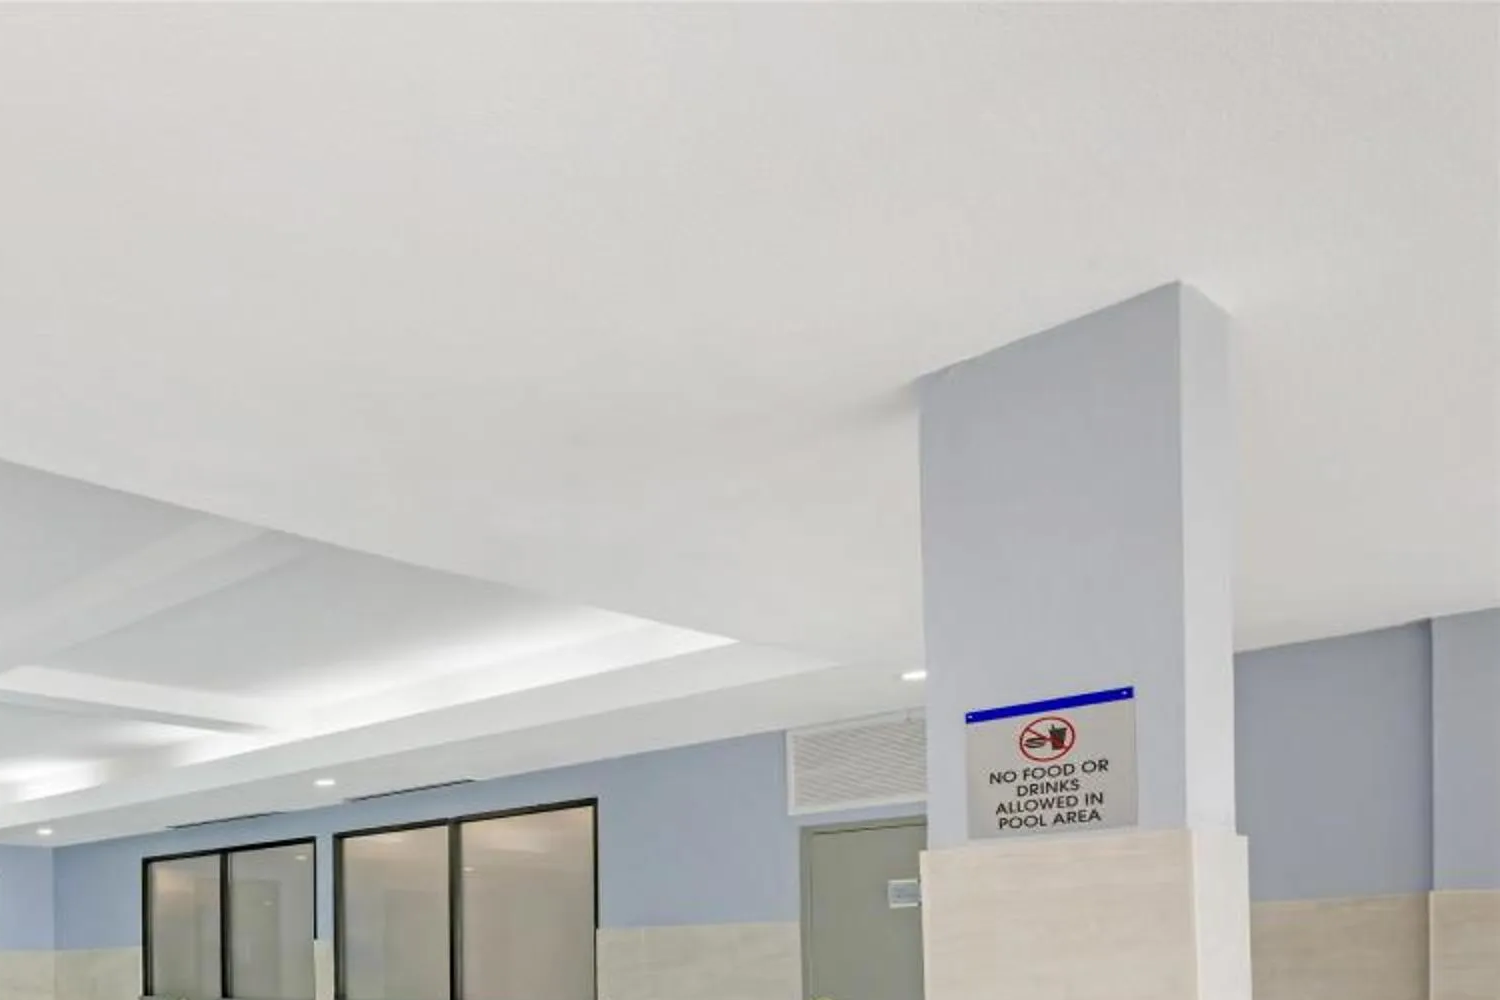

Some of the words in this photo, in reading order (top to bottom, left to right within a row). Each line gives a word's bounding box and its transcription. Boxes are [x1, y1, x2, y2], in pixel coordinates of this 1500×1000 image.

[989, 770, 1017, 785] NO
[1023, 763, 1075, 781] FOOD
[1081, 759, 1109, 773] OR
[1017, 779, 1080, 797] DRINKS
[996, 795, 1079, 815] ALLOWED
[1085, 792, 1103, 806] IN
[999, 815, 1048, 830] POOL
[1053, 809, 1102, 826] AREA
